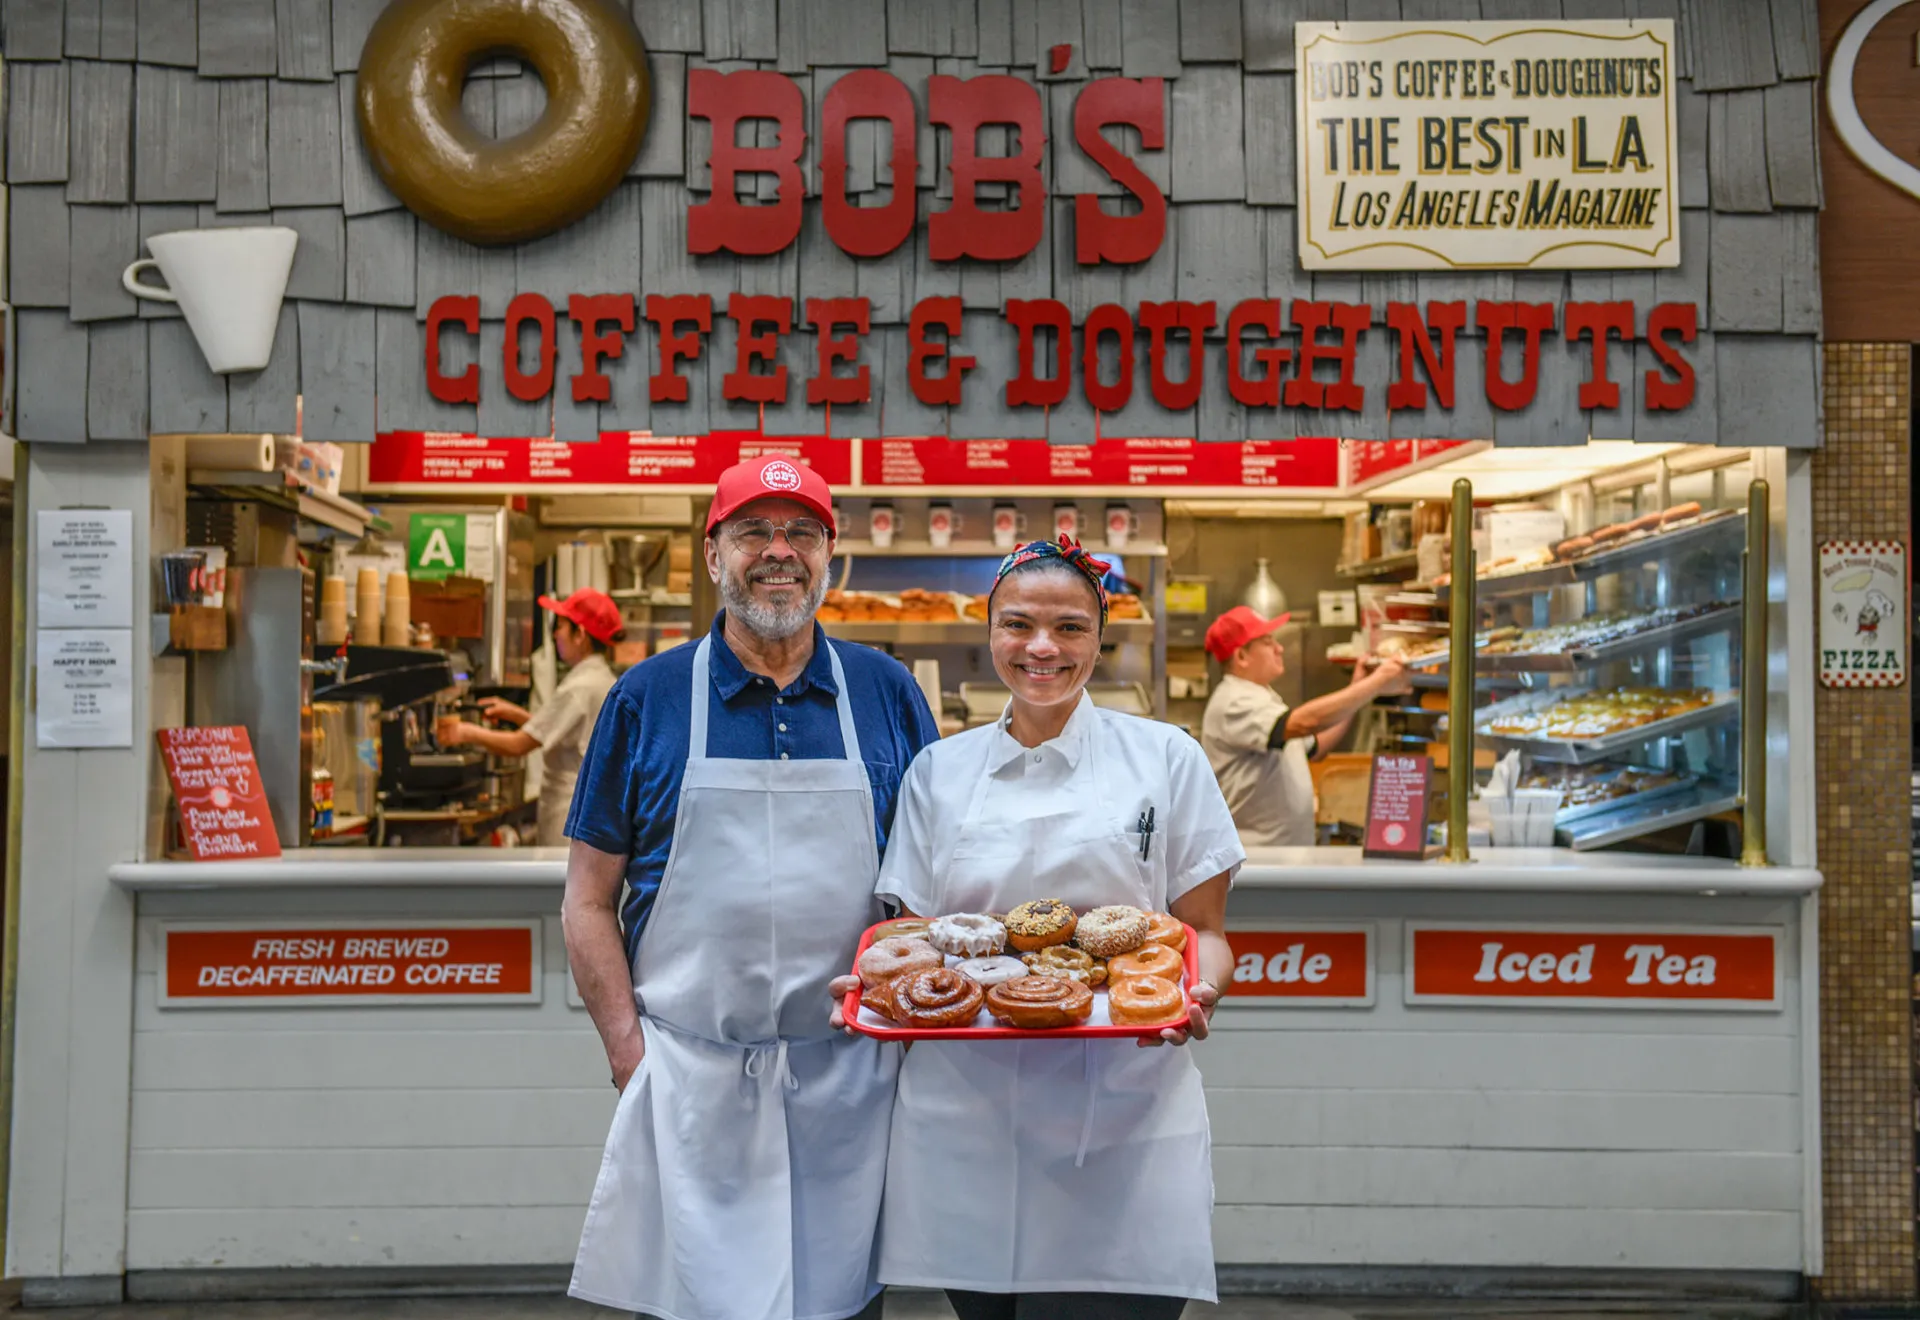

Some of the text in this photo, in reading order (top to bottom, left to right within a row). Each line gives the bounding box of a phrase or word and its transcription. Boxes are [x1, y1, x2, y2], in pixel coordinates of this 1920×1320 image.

[1310, 60, 1383, 99] BOB'S
[1395, 60, 1495, 98] COFFEE
[1511, 58, 1661, 98] DOUGHNUTS
[687, 44, 1166, 263] BOB'S
[1318, 116, 1654, 174] THE BEST IN L.A.
[425, 293, 1697, 414] COFFEE & DOUGHNUTS
[485, 458, 505, 469] TEA
[765, 471, 797, 484] BOB'S
[419, 528, 456, 567] A
[52, 658, 117, 666] HAPPY HOUR
[1823, 650, 1900, 669] PIZZA
[168, 727, 240, 744] SEASONAL
[252, 938, 449, 960] FRESH BREWED
[1233, 943, 1332, 984] ade
[198, 964, 502, 987] DECAFFEINATED COFFEE
[1475, 943, 1718, 987] Iced Tea
